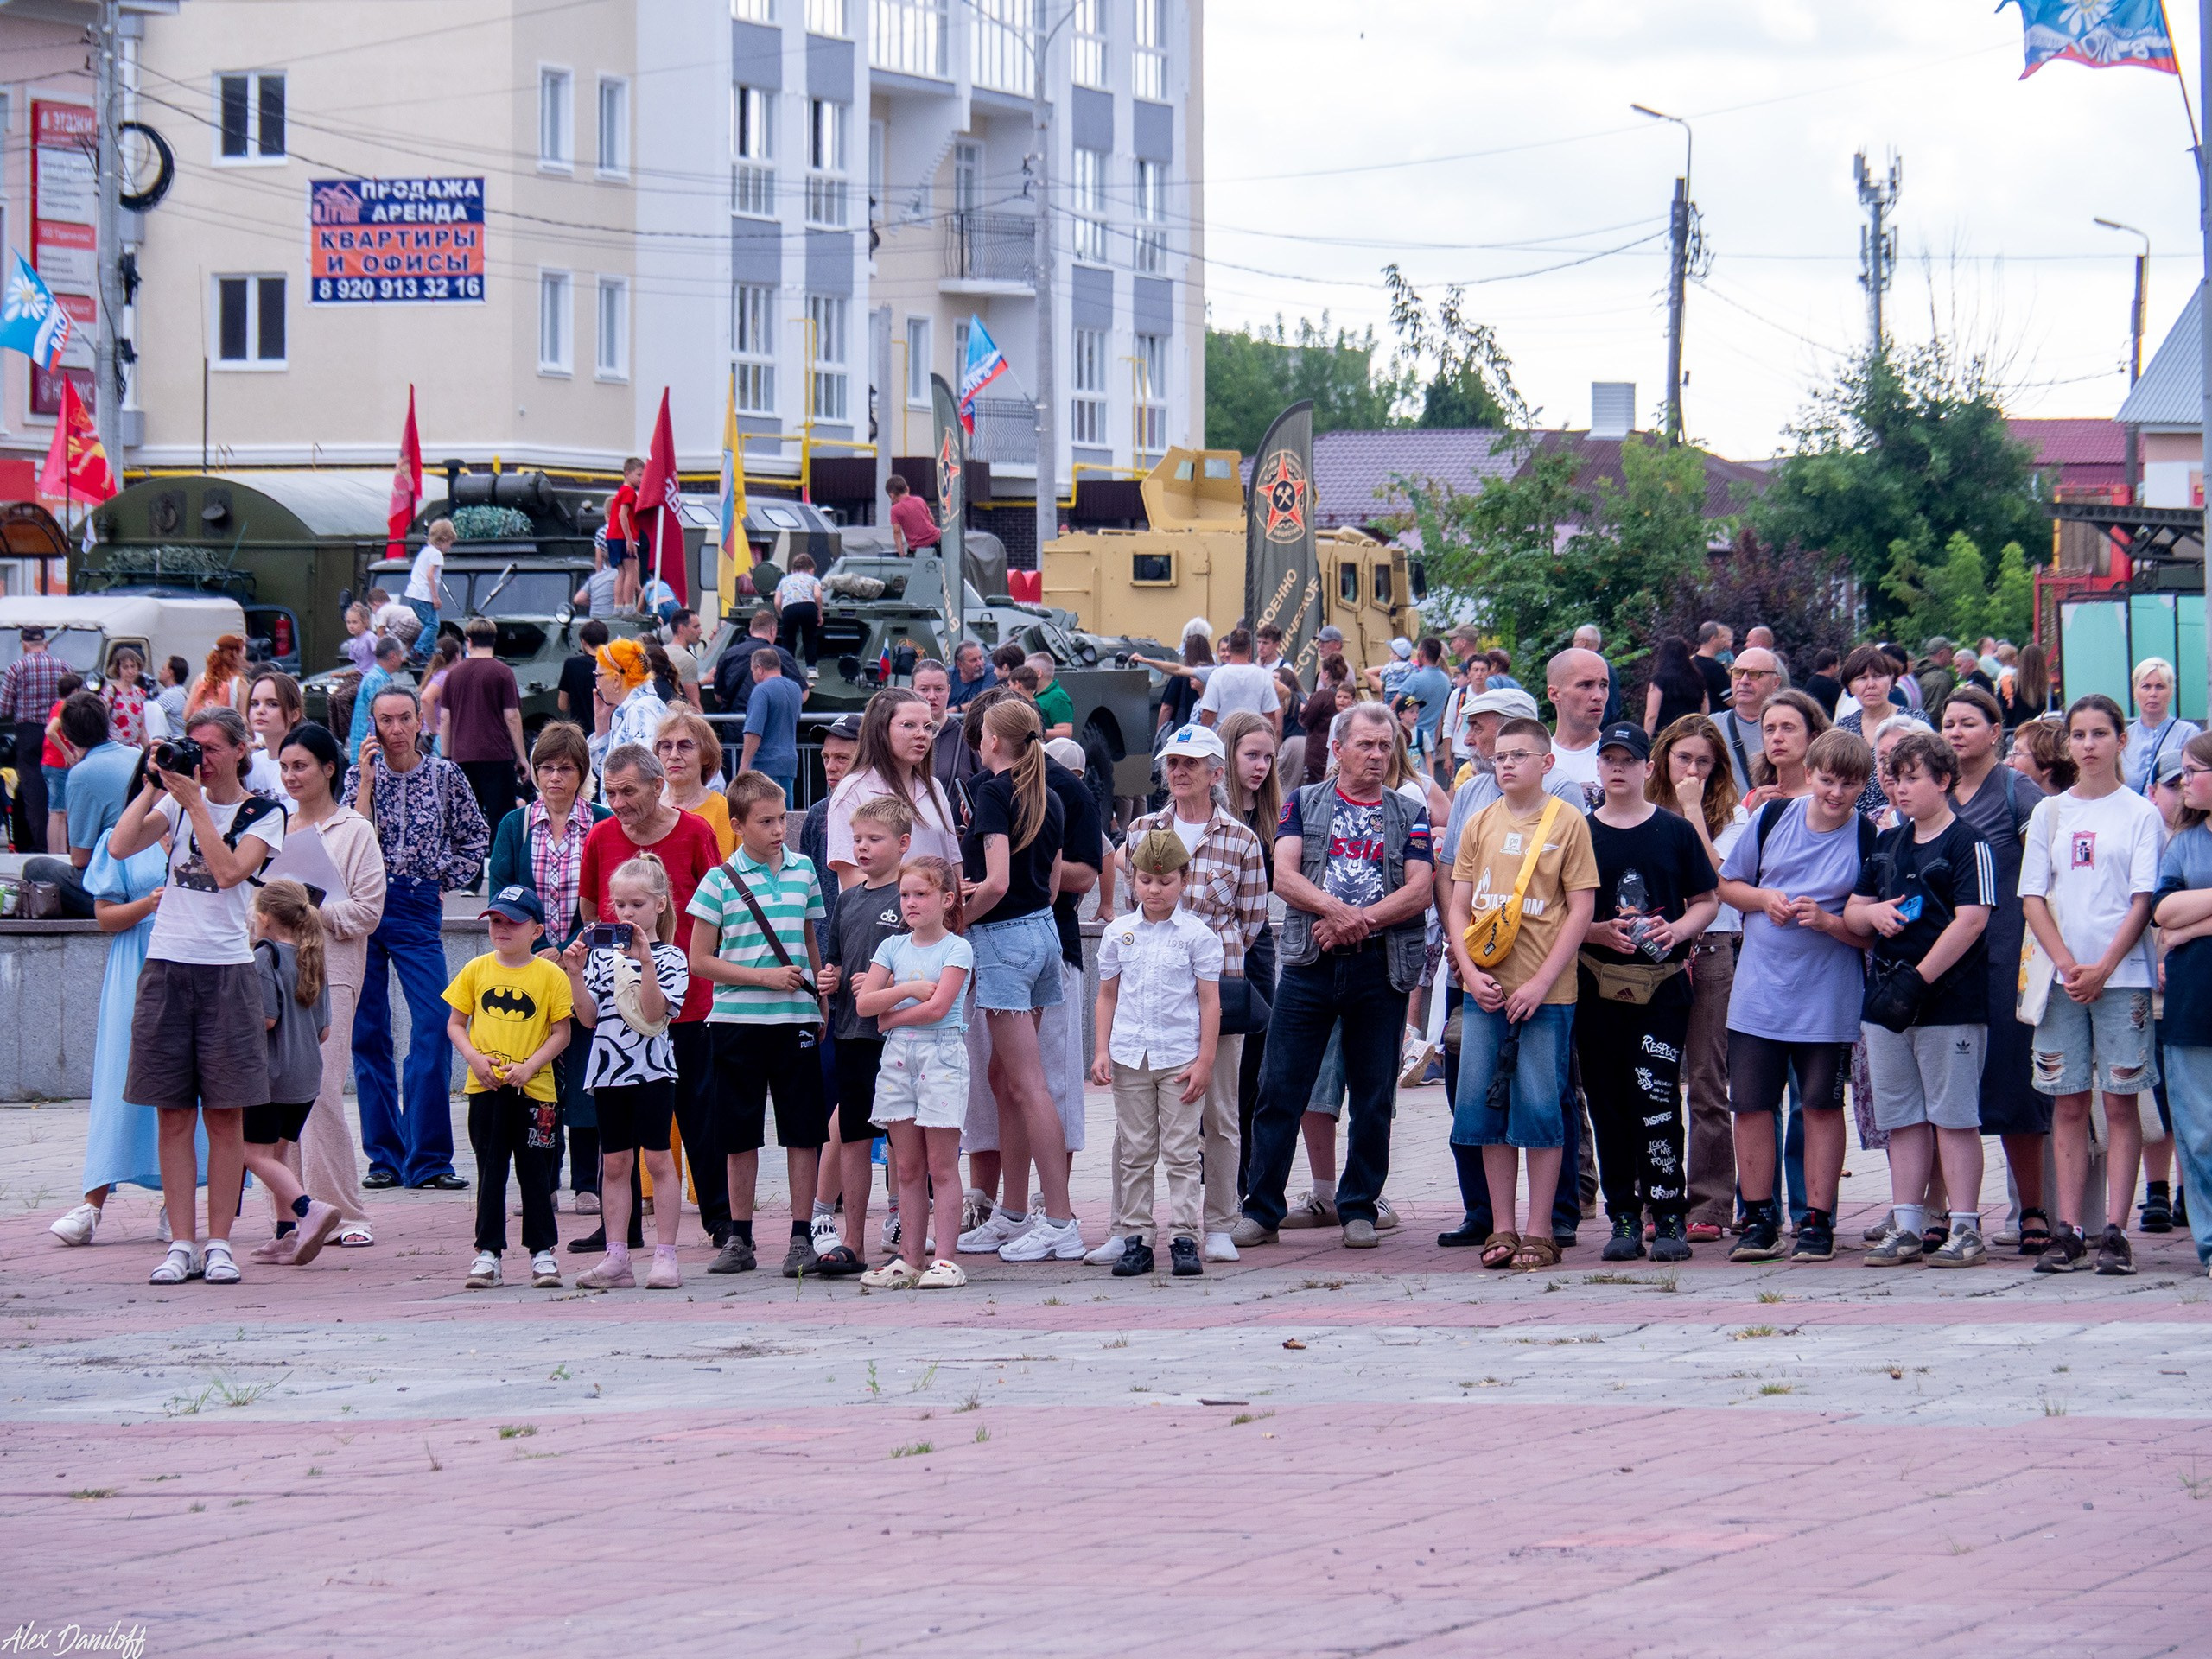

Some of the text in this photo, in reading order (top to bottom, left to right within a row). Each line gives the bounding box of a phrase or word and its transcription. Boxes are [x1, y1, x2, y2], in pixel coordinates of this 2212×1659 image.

[360, 181, 480, 201] ПРОДАЖА
[372, 203, 467, 224] АРЕНДА
[320, 229, 475, 250] КВАРТИРЫ
[327, 253, 469, 273] И ОФИСЫ
[319, 276, 480, 299] 8 920 913 32 16
[1256, 569, 1297, 629] ВОЕННО
[1277, 577, 1319, 657] НИЧЕСКОЕ
[1329, 834, 1384, 863] SSIA
[1472, 880, 1544, 916] ГАЗОМ
[1166, 939, 1189, 950] 1981
[1641, 1034, 1680, 1060] RESPECT
[1647, 1147, 1672, 1158] AT ME
[1649, 1139, 1669, 1148] LOOK
[1650, 1154, 1676, 1166] FOLLOW
[1662, 1165, 1675, 1175] ME
